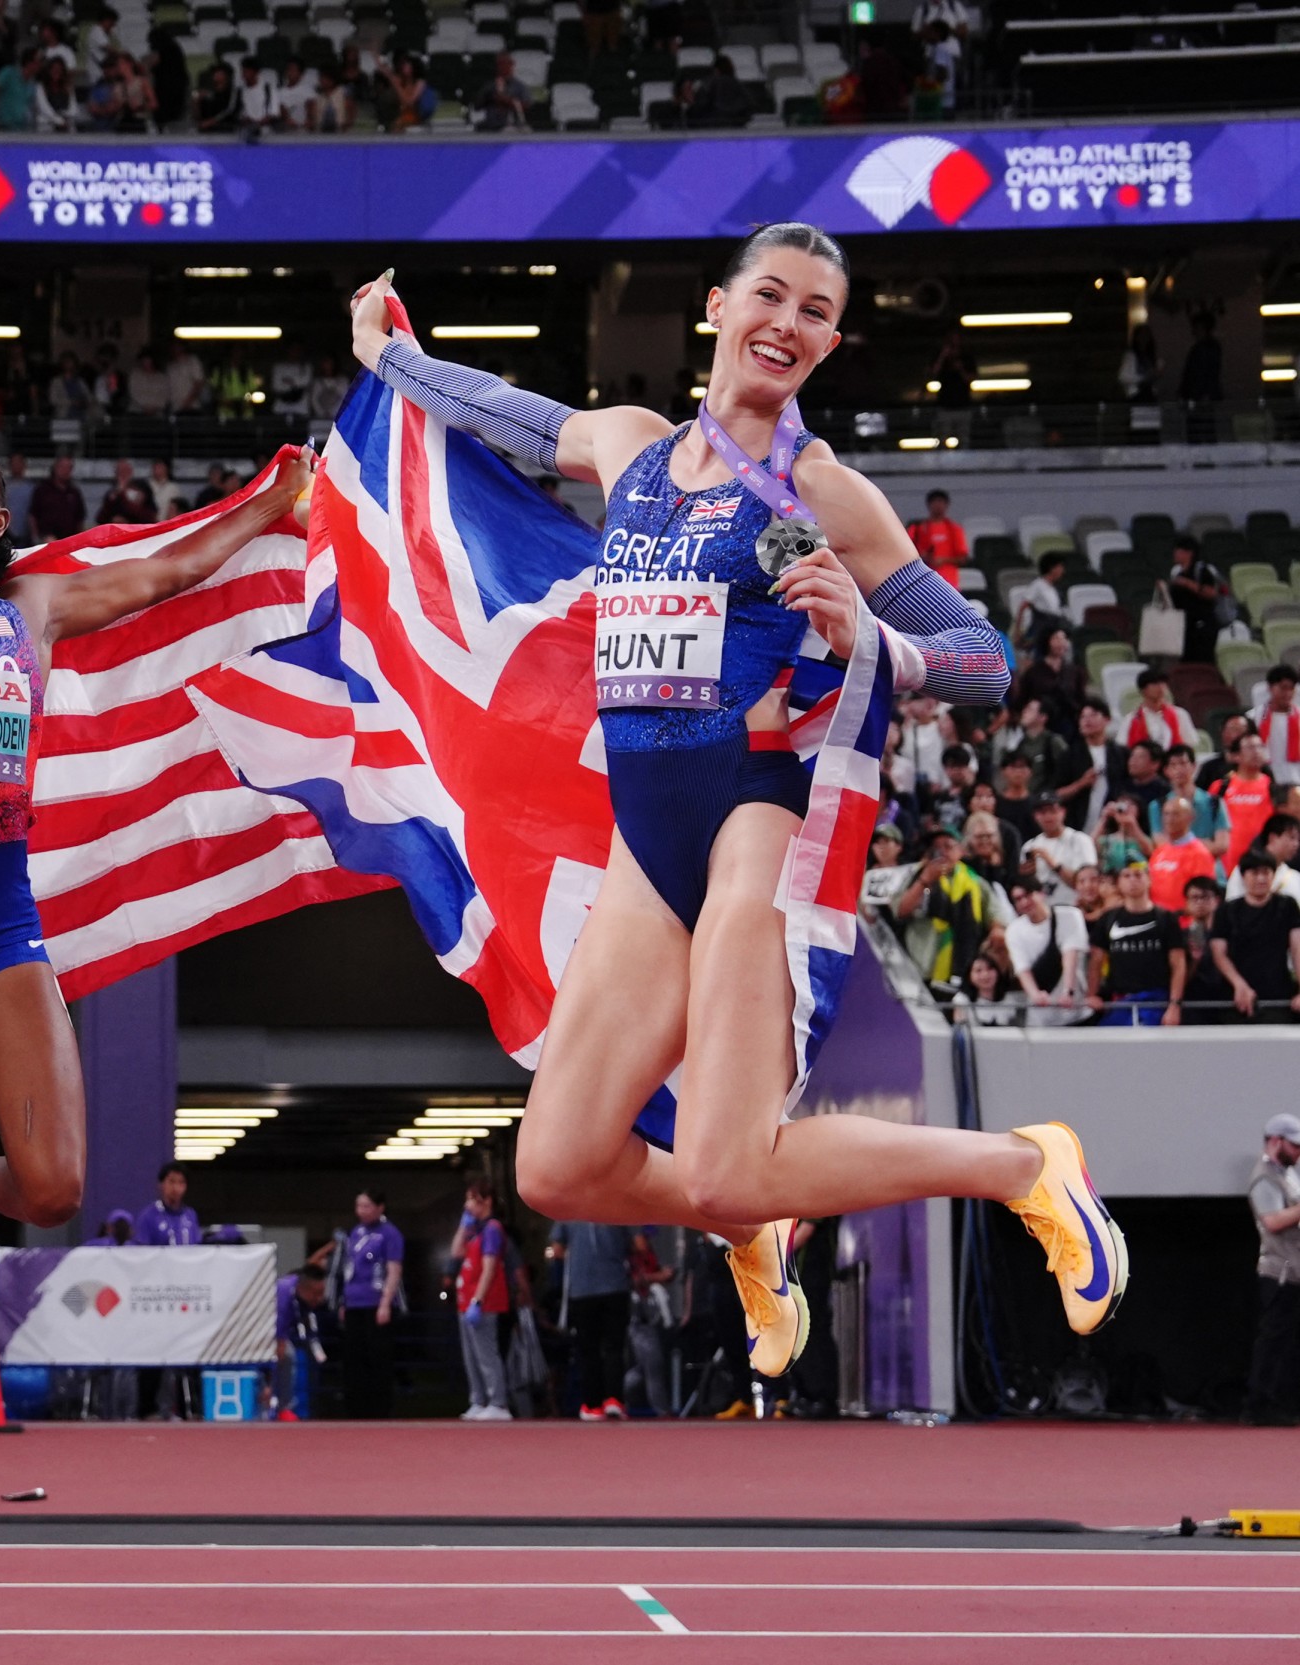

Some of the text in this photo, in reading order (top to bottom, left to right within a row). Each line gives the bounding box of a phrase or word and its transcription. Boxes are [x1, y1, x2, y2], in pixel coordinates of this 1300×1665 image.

[1004, 141, 1192, 166] WORLD ATHLETICS
[28, 161, 213, 181] WORLD ATHLETICS
[1004, 161, 1192, 187] CHAMPIONSHIPS
[27, 181, 213, 202] CHAMPIONSHIPS
[680, 522, 732, 534] Novuna
[604, 528, 715, 569] GREAT
[597, 633, 698, 672] HUNT
